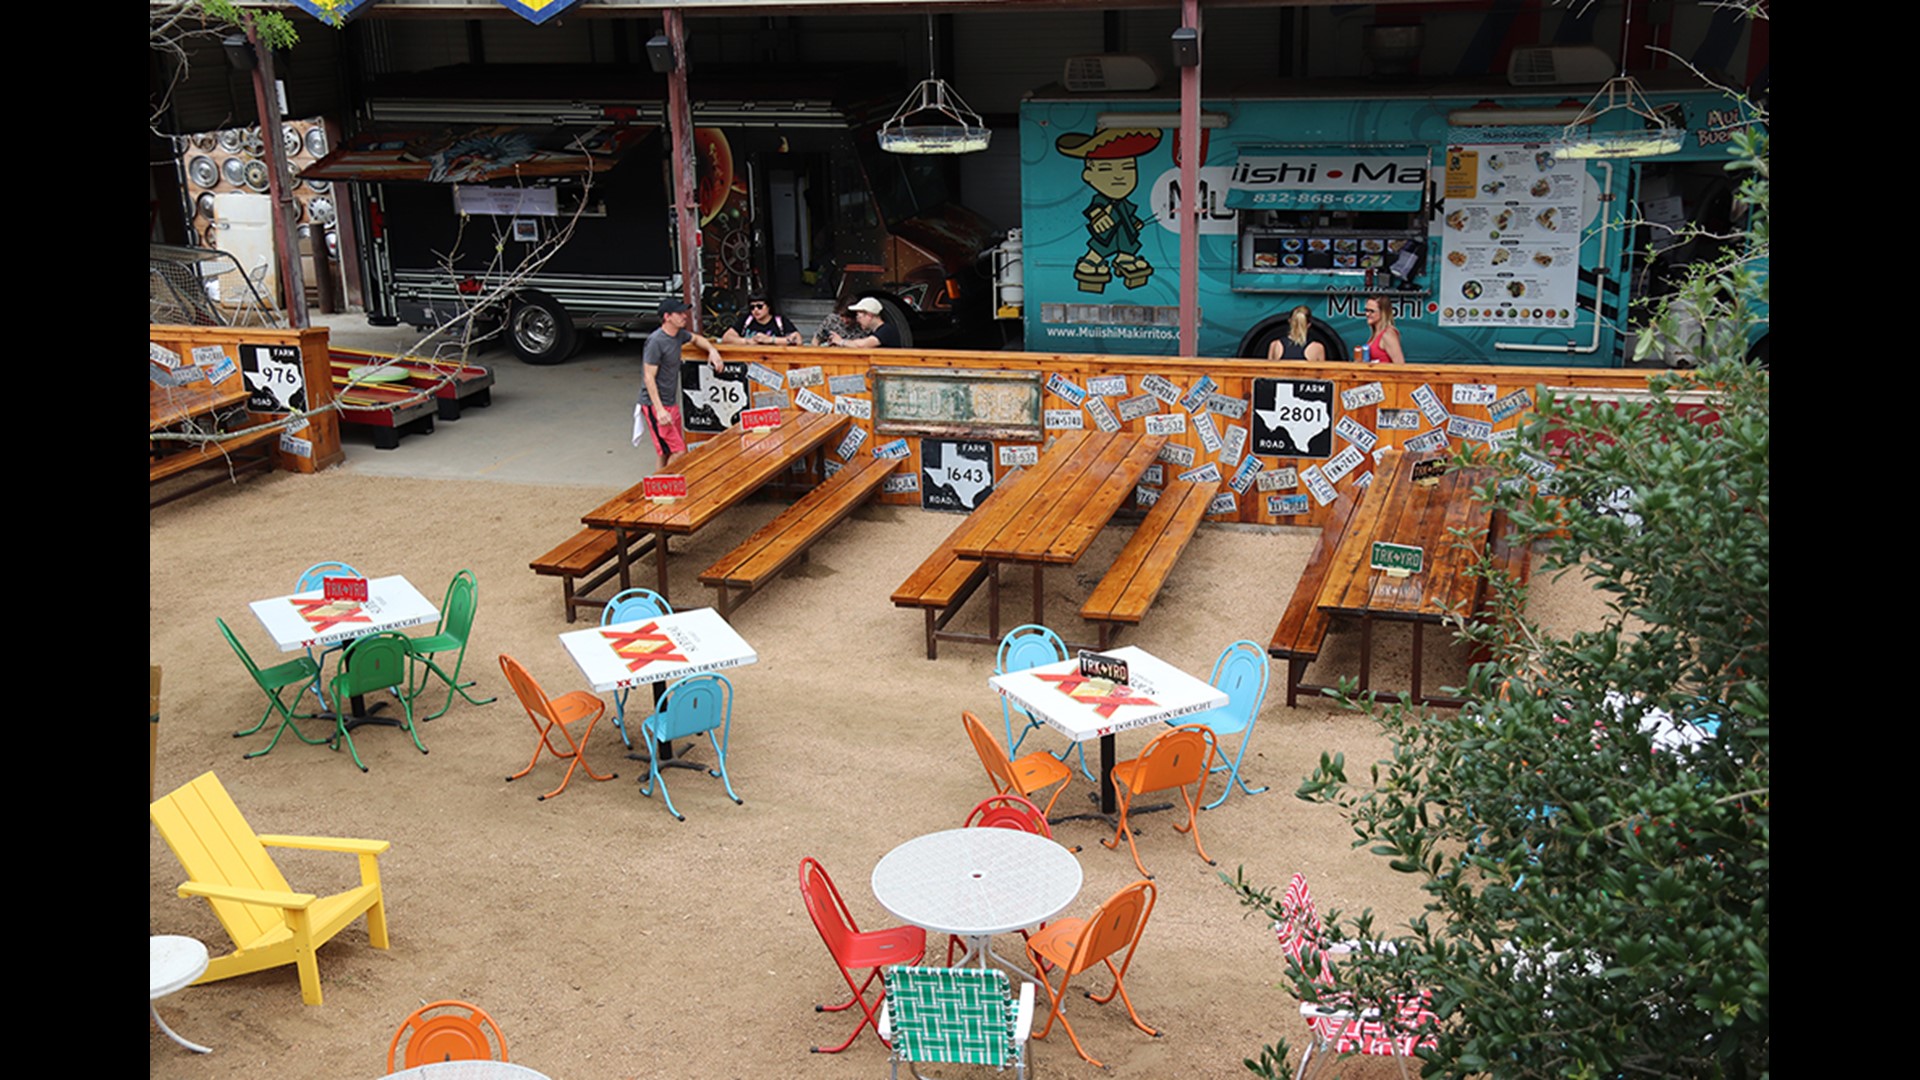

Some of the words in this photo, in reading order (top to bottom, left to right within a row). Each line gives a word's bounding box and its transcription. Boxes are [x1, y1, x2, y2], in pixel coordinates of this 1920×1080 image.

[1253, 192, 1392, 204] 832-868-6777
[262, 368, 296, 384] 976
[708, 386, 740, 403] 216
[1299, 384, 1326, 392] FARM
[252, 398, 272, 406] ROAD
[690, 416, 712, 425] ROAD
[1280, 406, 1322, 422] 2801
[962, 444, 986, 452] FARM
[1259, 440, 1285, 448] ROAD
[947, 467, 983, 482] 1643
[929, 496, 952, 504] ROAD
[301, 639, 316, 648] XX
[320, 634, 338, 643] DOS
[367, 626, 380, 634] ON
[382, 617, 422, 631] DRAUGHT
[617, 678, 632, 688] XX
[636, 674, 654, 683] DOS
[655, 670, 682, 680] EQUIS
[684, 666, 696, 674] ON
[699, 658, 740, 672] DRAUGHT
[1097, 727, 1111, 736] XX
[1115, 722, 1132, 731] DOS
[1133, 716, 1158, 727] EQUIS
[1159, 711, 1172, 720] ON
[1174, 702, 1212, 716] DRAUGHT
